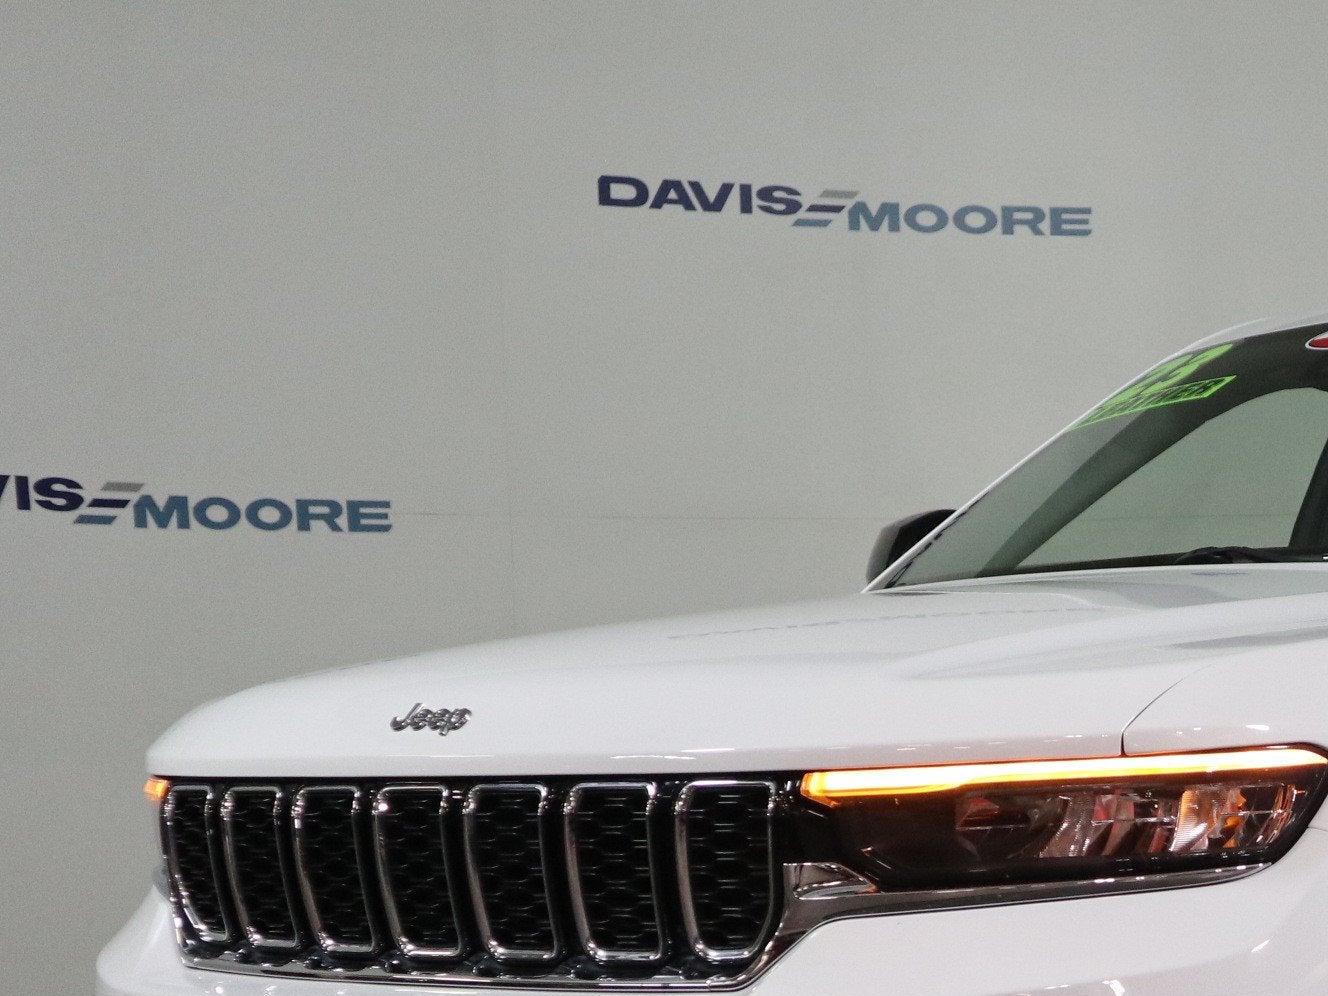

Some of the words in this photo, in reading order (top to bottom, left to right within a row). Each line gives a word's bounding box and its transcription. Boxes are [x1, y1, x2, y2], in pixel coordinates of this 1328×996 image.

[597, 174, 803, 217] DAVIS
[847, 201, 1093, 238] MOORE
[133, 493, 393, 533] MOORE
[390, 702, 472, 737] Jeep
